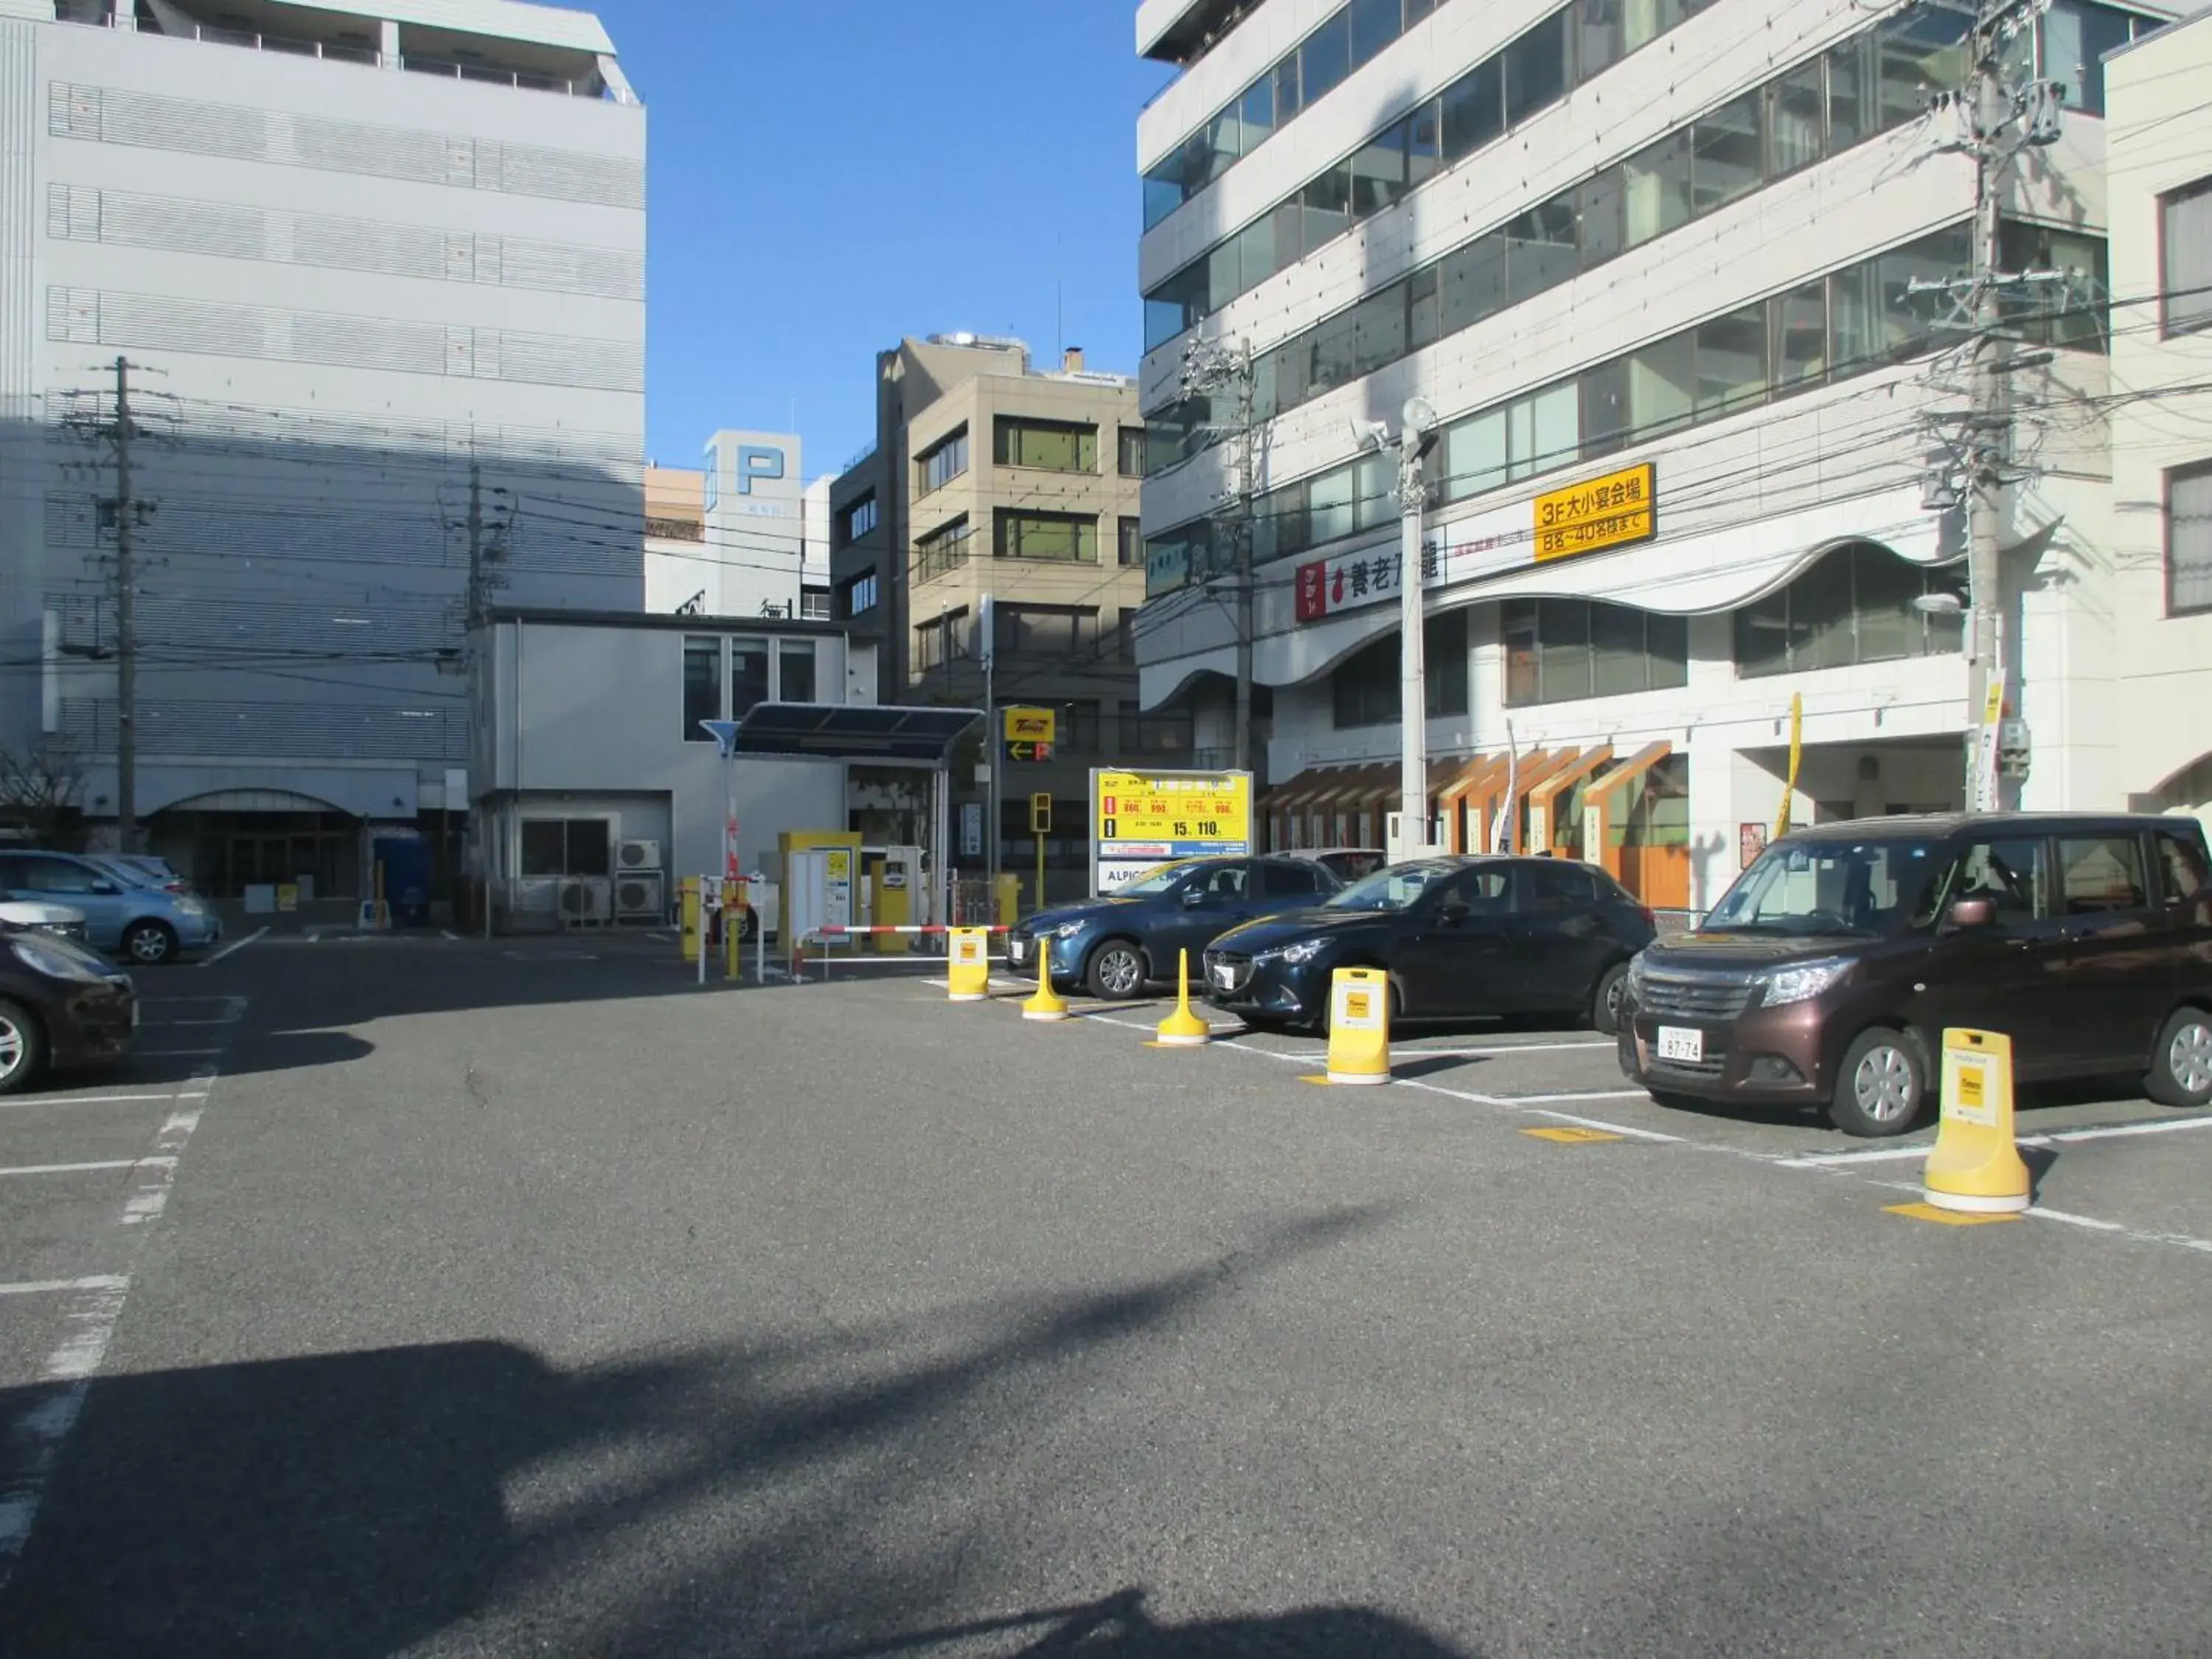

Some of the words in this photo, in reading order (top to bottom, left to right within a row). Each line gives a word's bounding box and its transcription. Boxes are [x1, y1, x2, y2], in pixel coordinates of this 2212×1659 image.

[737, 445, 784, 495] P
[1543, 477, 1641, 526] 3F大小宴会場
[1197, 821, 1217, 835] 110
[1667, 1040, 1698, 1057] 87-74
